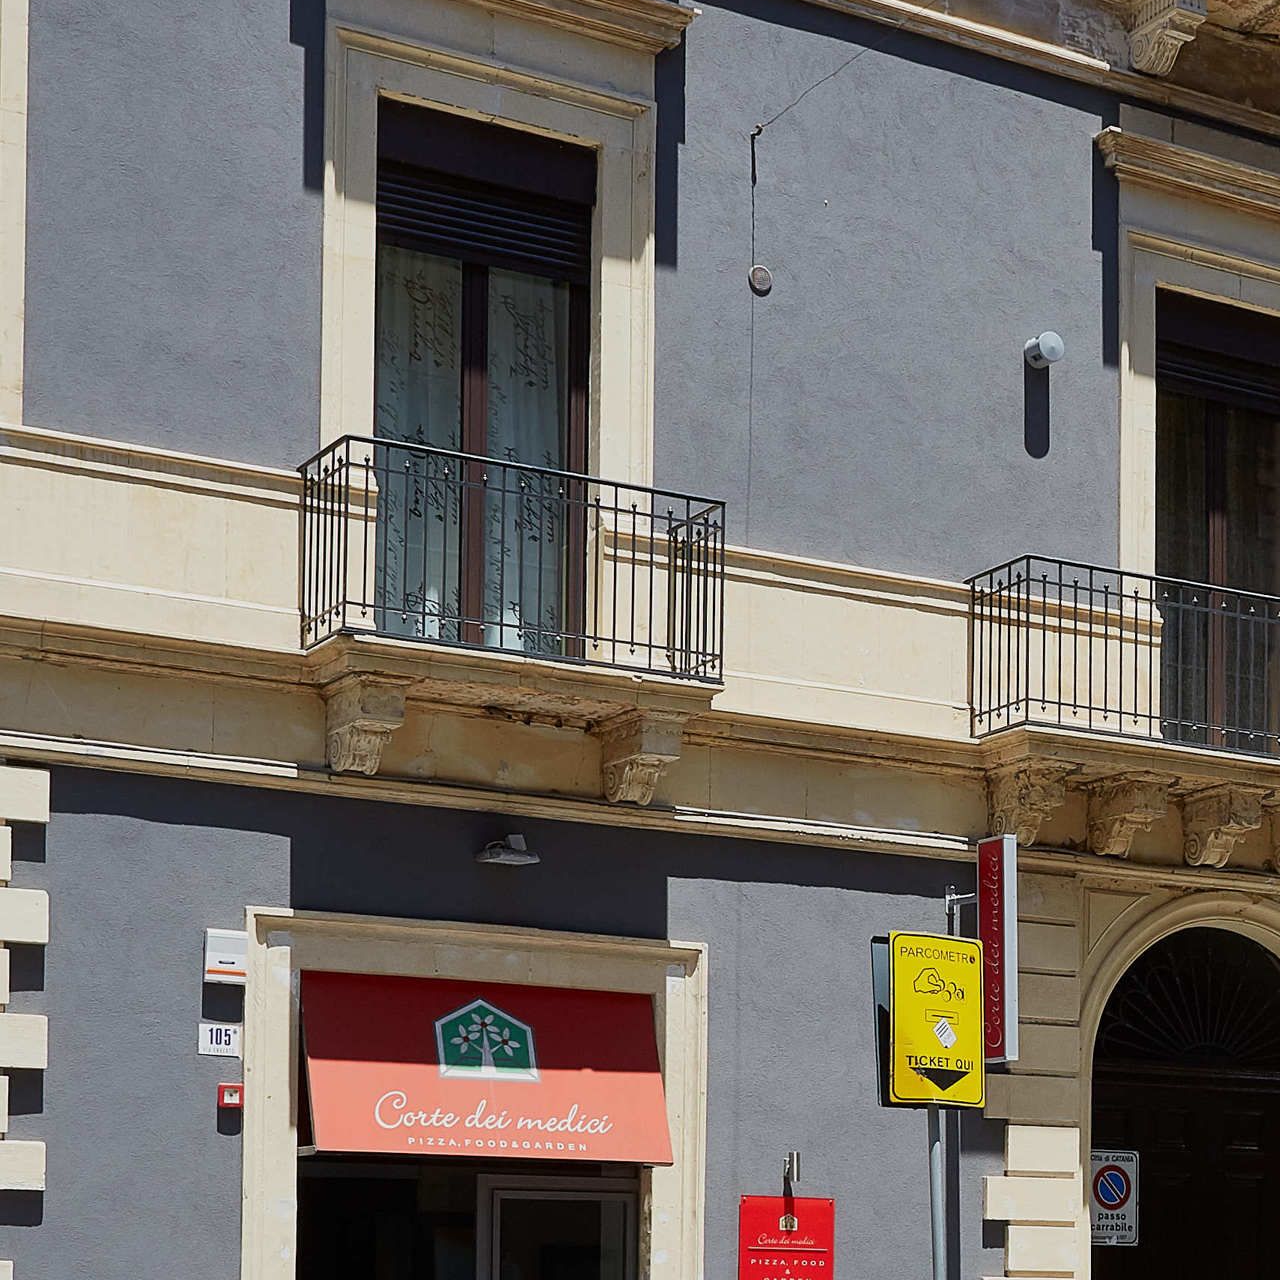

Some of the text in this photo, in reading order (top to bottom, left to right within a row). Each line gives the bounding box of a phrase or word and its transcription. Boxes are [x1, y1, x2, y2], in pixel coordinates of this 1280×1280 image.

[906, 1055, 974, 1071] TICKET QUI
[374, 1090, 614, 1135] Corte dei medici
[1097, 1212, 1127, 1221] passo
[1091, 1222, 1133, 1232] carrabile
[750, 1258, 825, 1267] PIZZA, FOOD
